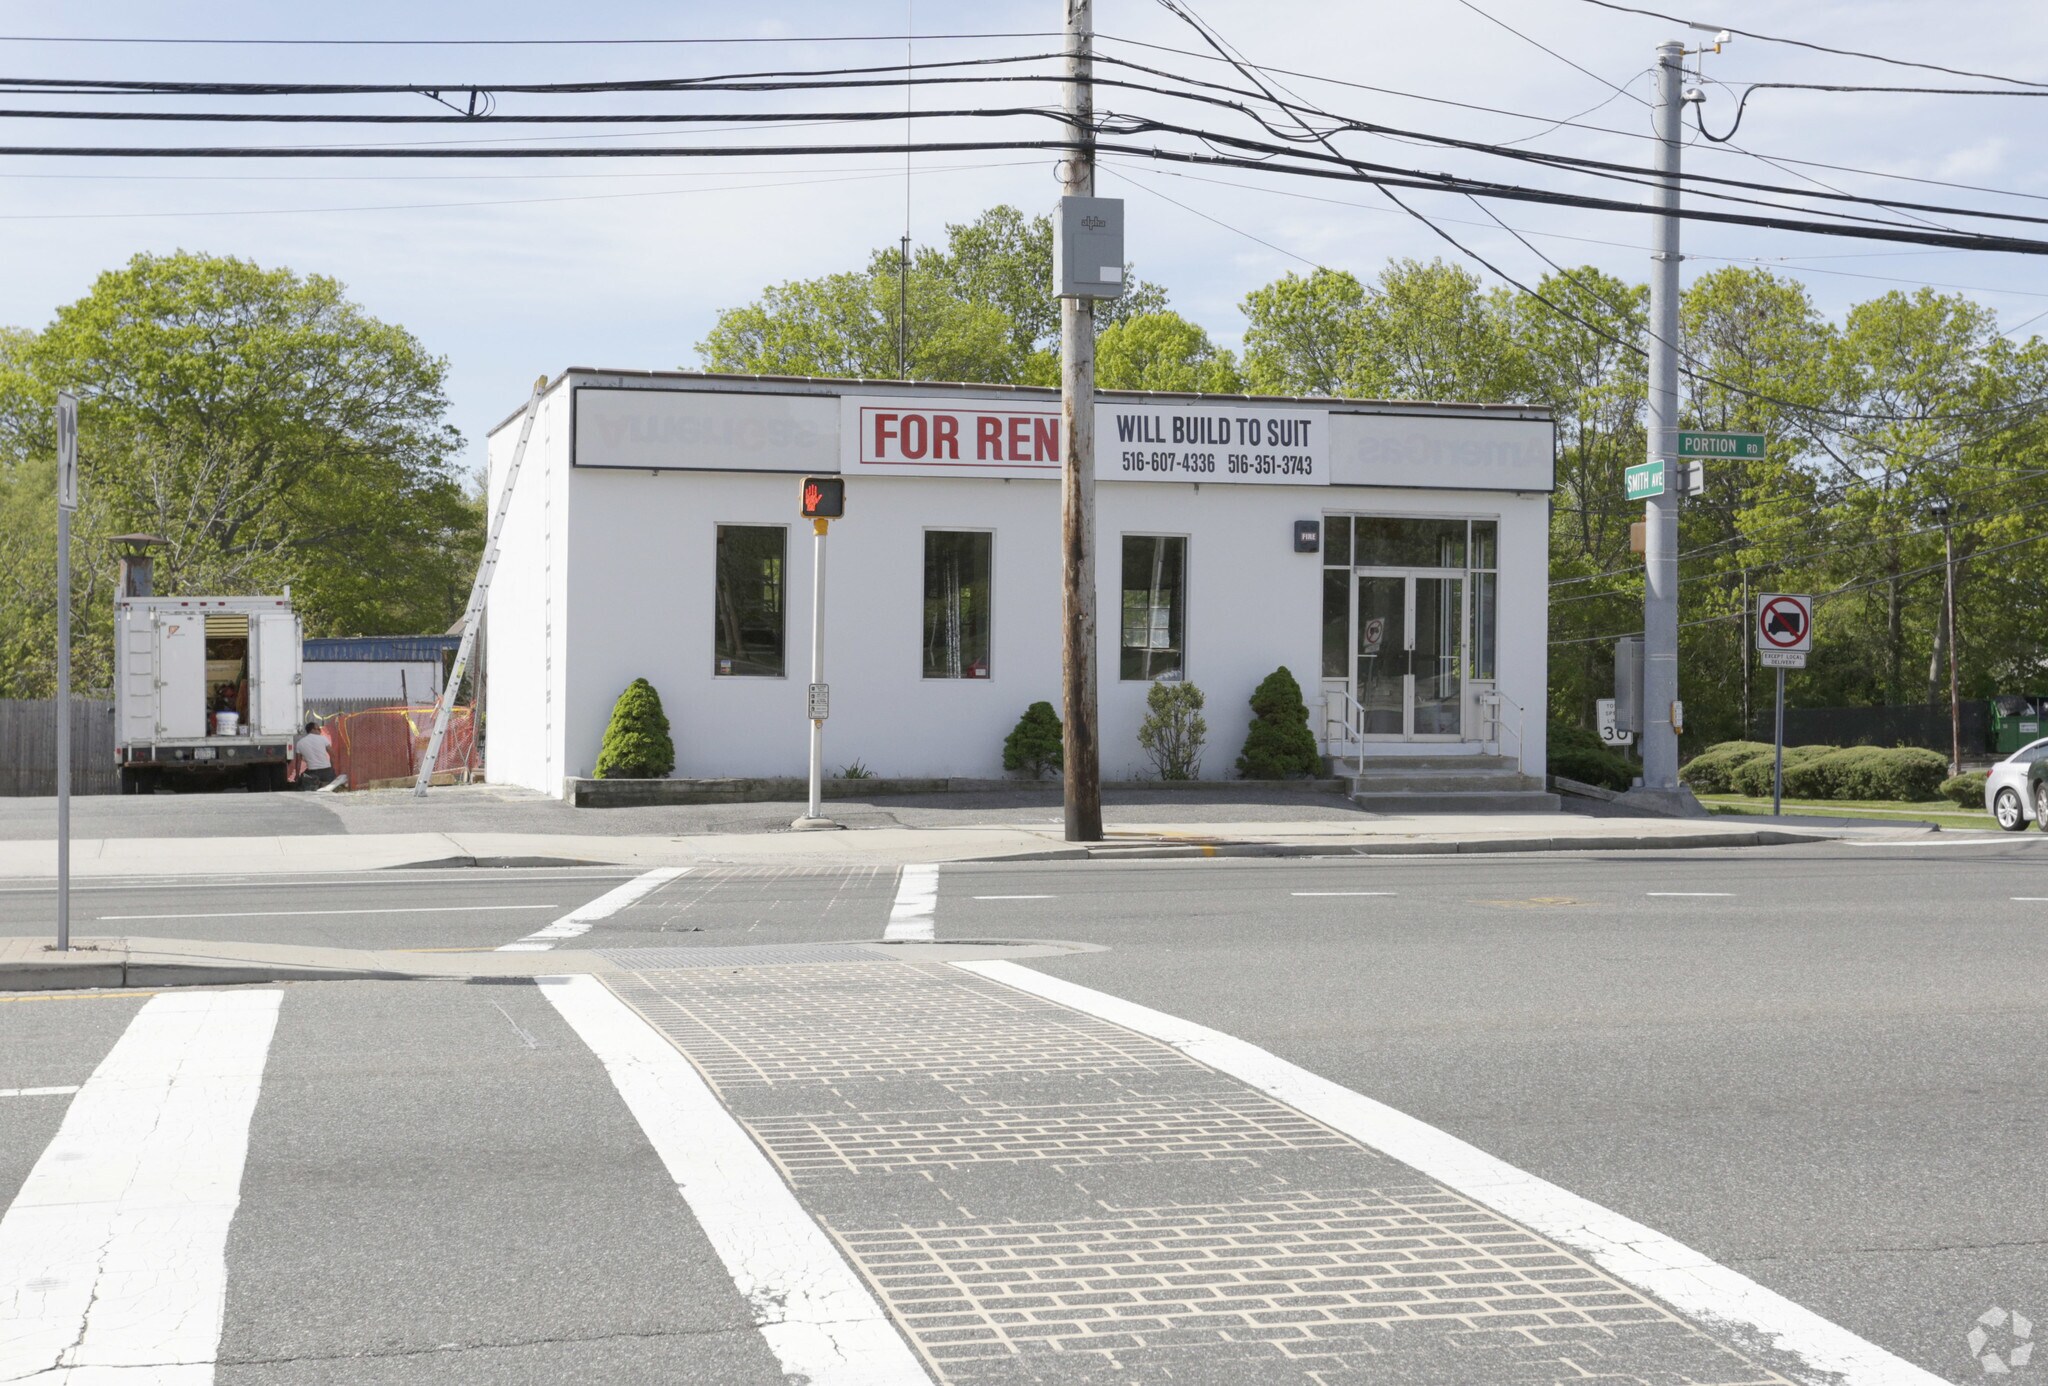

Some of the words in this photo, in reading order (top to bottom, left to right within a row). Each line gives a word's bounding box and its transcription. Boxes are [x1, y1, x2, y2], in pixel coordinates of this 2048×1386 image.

[1081, 216, 1106, 230] alpha
[874, 413, 959, 460] FOR
[977, 416, 1060, 462] REN
[1116, 415, 1166, 443] WILL
[1172, 416, 1231, 445] BUILD
[1236, 418, 1261, 447] TO
[1267, 418, 1312, 447] SUIT
[1684, 437, 1737, 453] PORTION
[1746, 443, 1758, 454] RD
[1122, 451, 1216, 473] 516-607-4336
[1228, 453, 1313, 475] 516-351-3743
[1627, 470, 1649, 493] SMITH
[1651, 471, 1663, 487] AVE
[1603, 726, 1628, 740] 30
